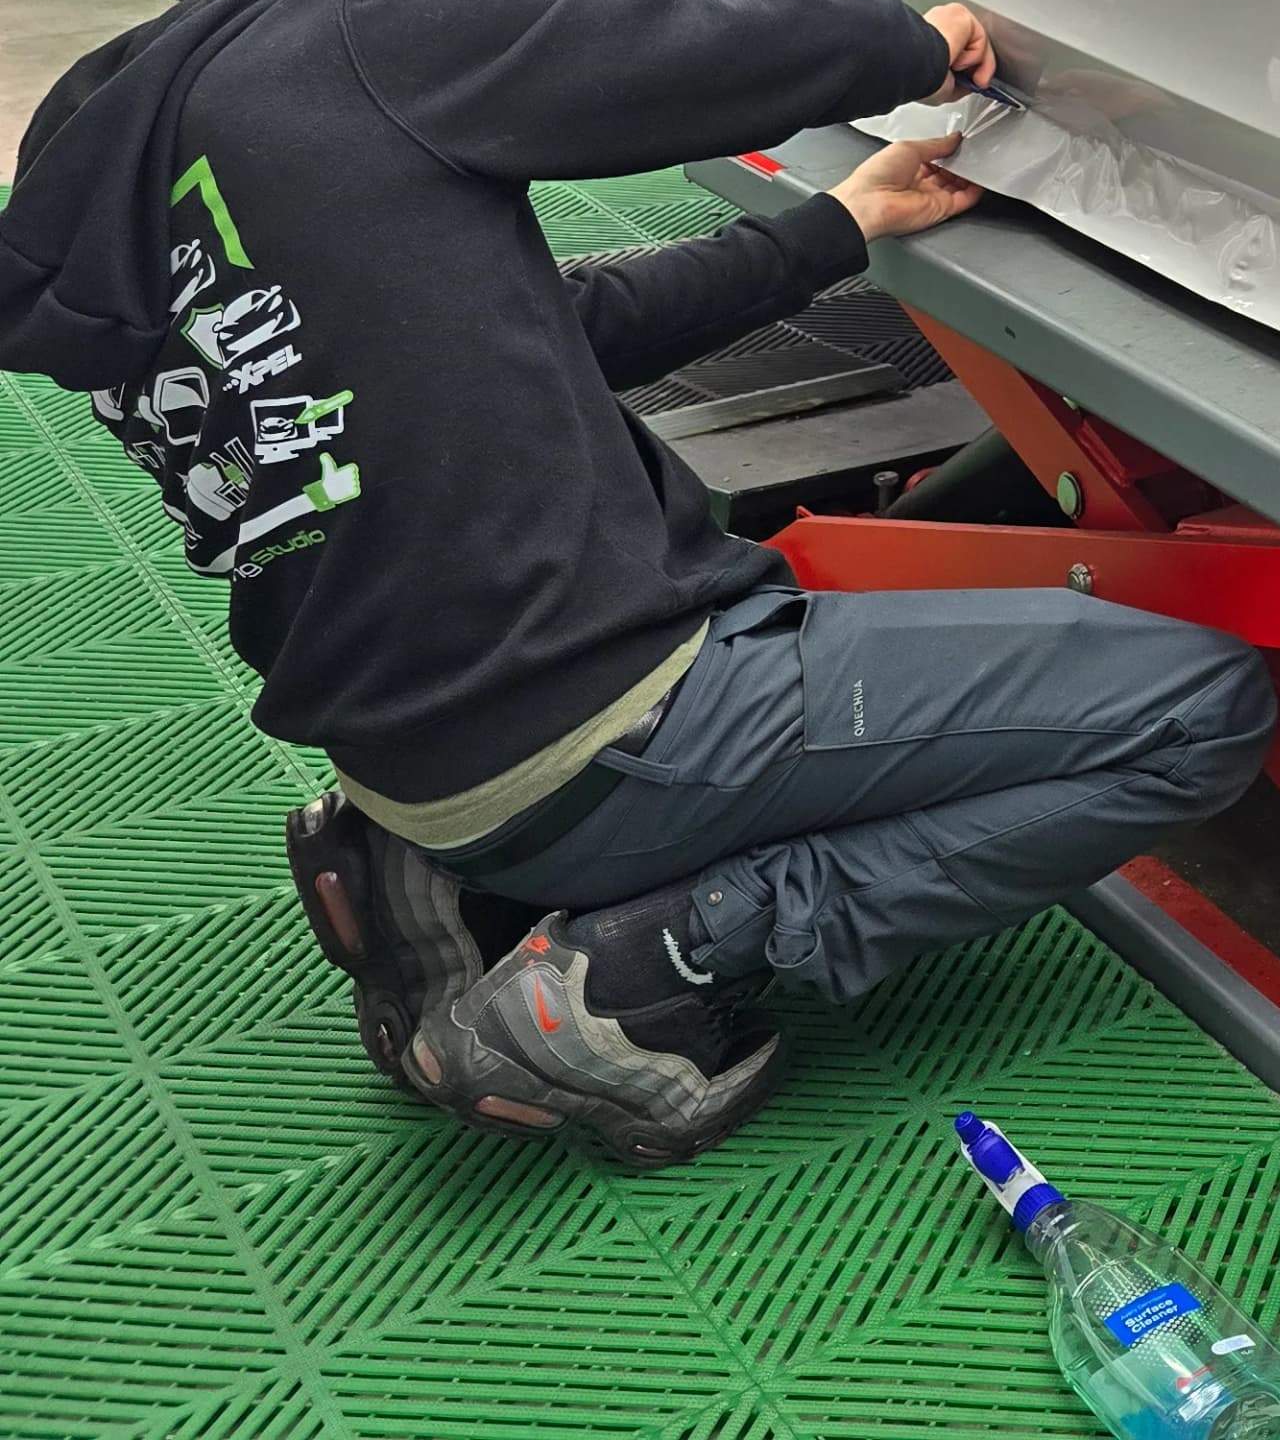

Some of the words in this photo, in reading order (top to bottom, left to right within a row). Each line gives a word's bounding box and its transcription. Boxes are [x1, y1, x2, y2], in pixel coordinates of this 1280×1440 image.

[224, 343, 303, 394] XPEL
[852, 679, 866, 737] QUECHUA
[1124, 1299, 1174, 1328] Surface
[1131, 1304, 1178, 1334] Cleaner
